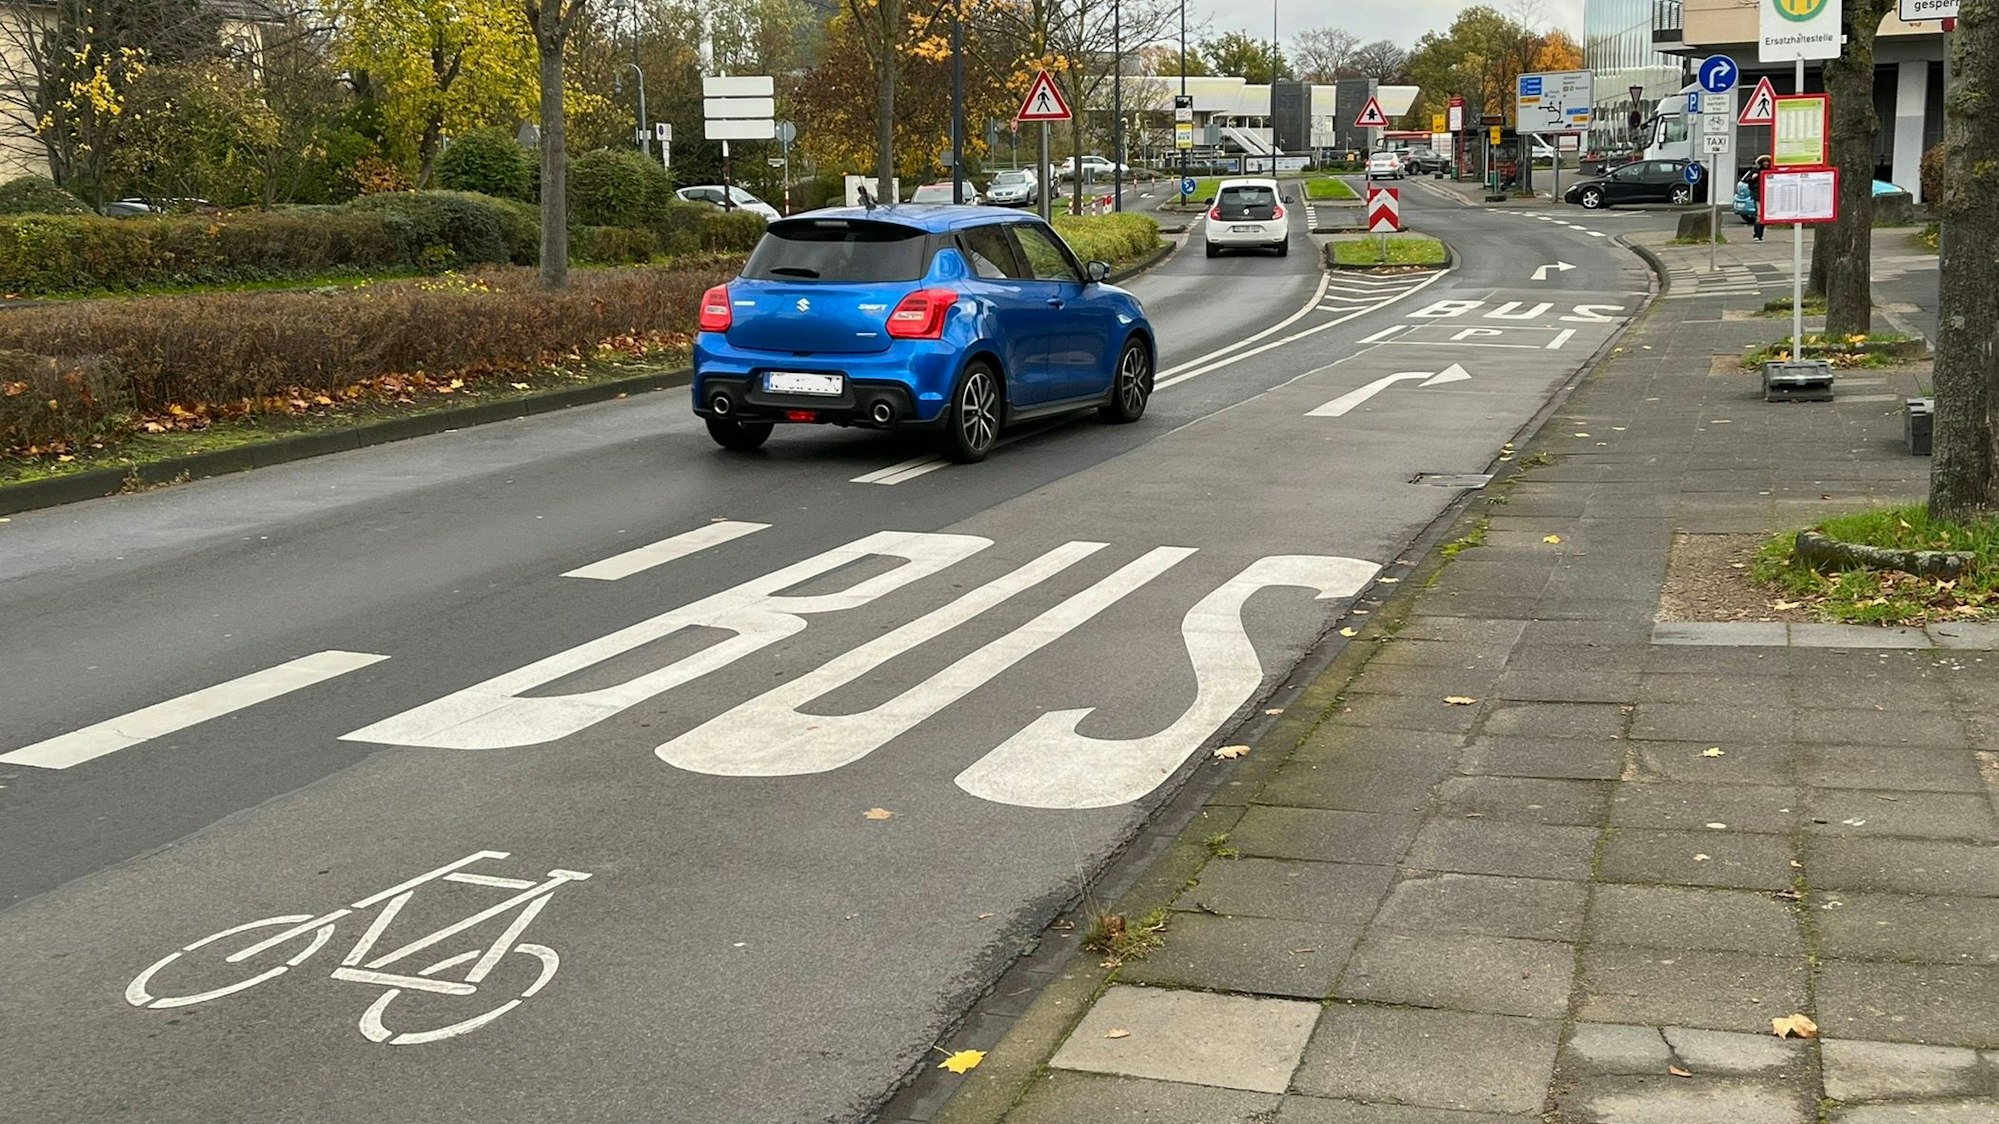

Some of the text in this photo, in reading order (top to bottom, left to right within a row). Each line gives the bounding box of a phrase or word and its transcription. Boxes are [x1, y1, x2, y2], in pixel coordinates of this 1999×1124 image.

[1914, 0, 1960, 12] gesperr
[1765, 33, 1833, 45] Ersatzhaltestelle
[1690, 94, 1697, 110] P
[1706, 137, 1727, 147] TAXI
[1405, 300, 1625, 323] BUS
[1450, 327, 1503, 341] P
[337, 530, 1383, 810] BUS
